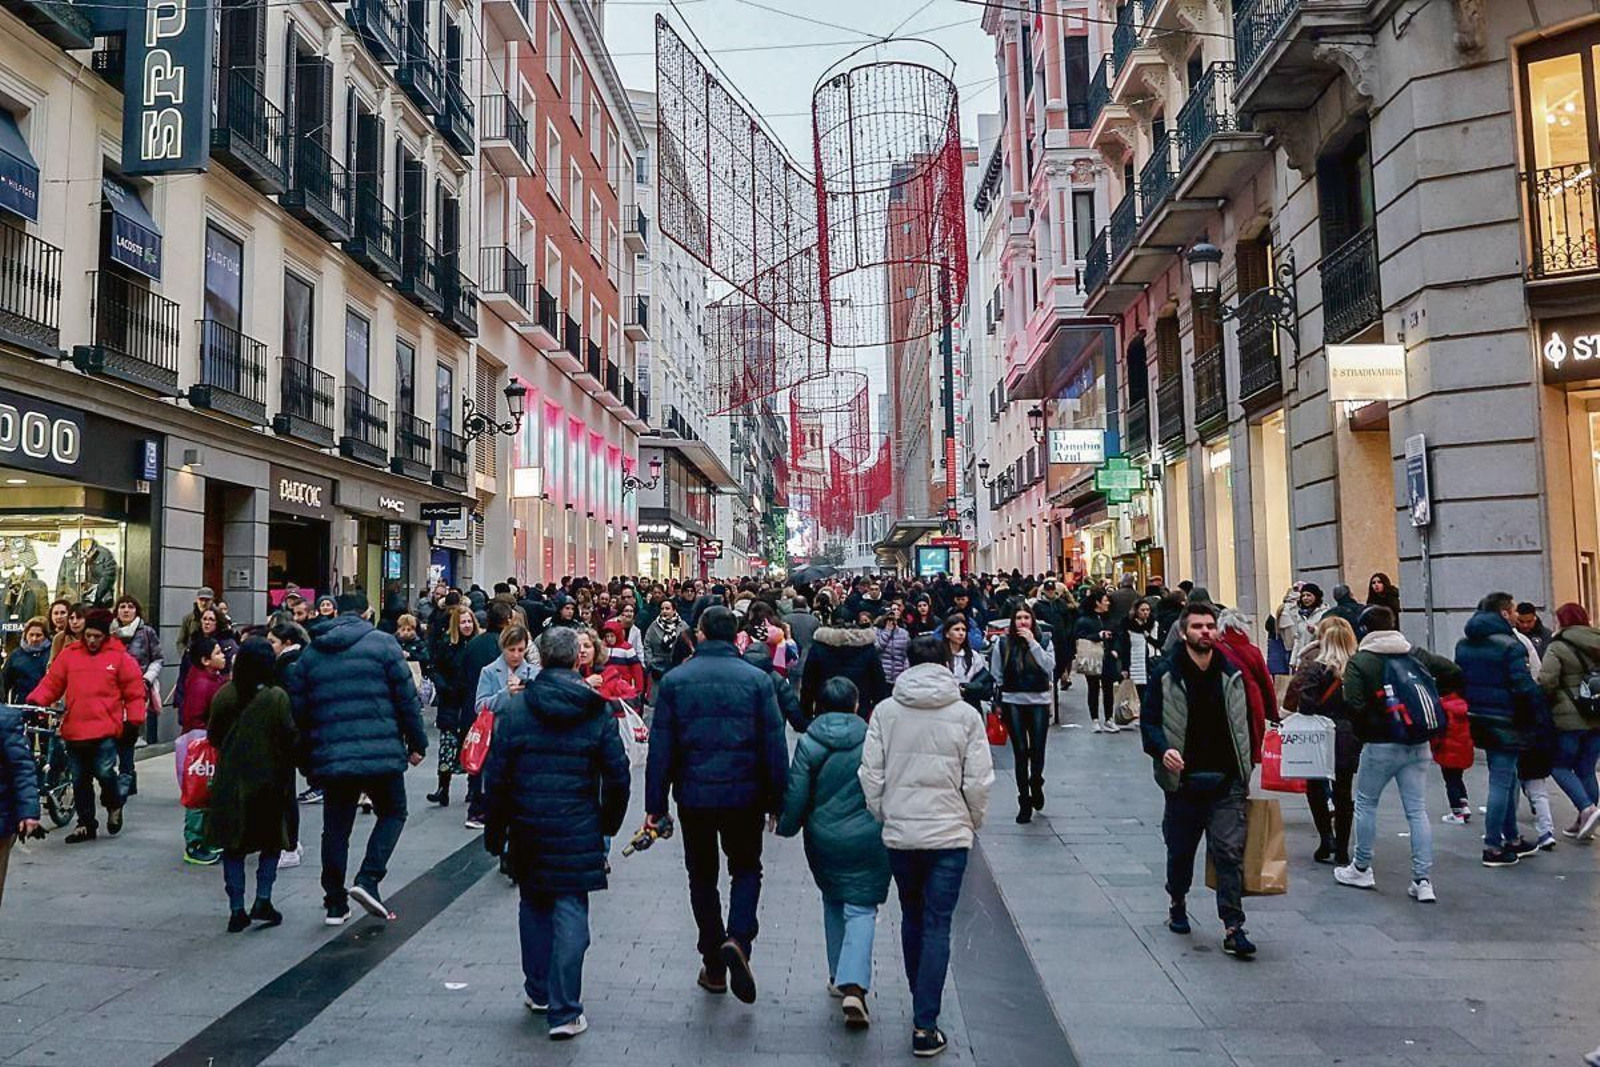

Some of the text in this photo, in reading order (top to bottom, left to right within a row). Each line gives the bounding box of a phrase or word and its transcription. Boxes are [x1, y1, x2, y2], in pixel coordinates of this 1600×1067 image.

[116, 235, 144, 257] LACOSTE
[1053, 431, 1066, 441] El
[1055, 452, 1081, 461] Azul
[379, 496, 405, 513] MAC
[422, 506, 460, 515] MAC
